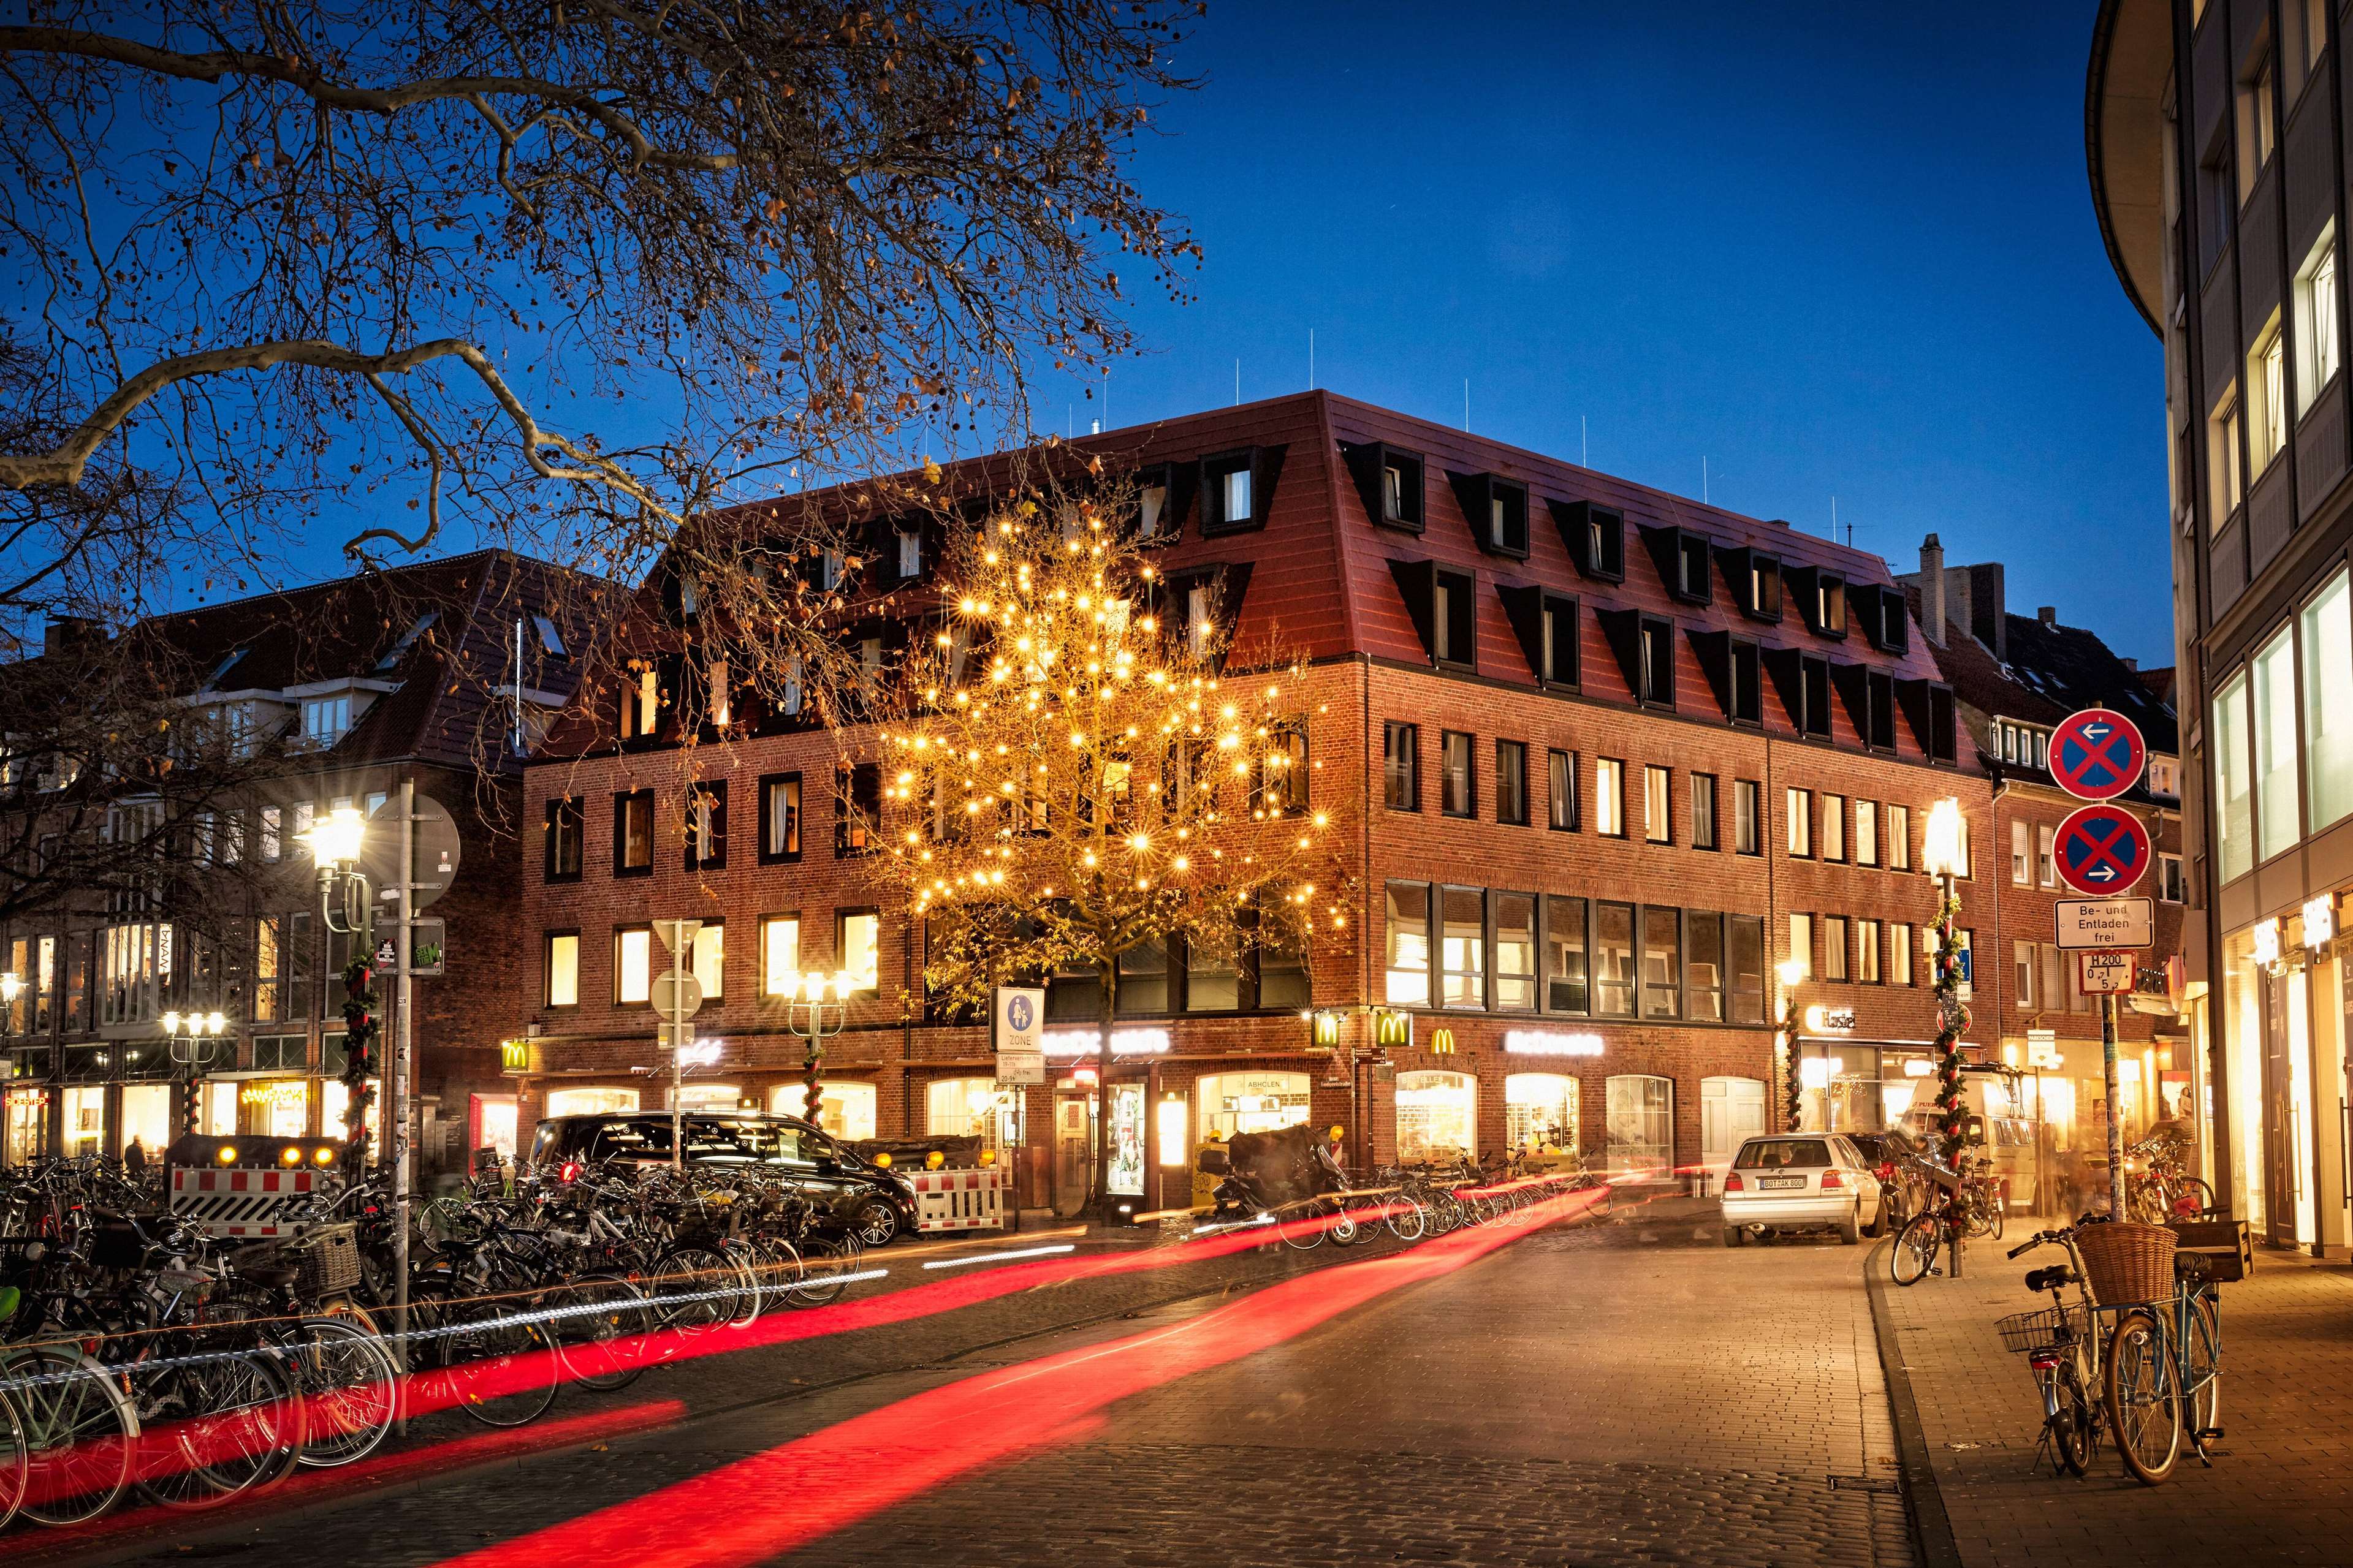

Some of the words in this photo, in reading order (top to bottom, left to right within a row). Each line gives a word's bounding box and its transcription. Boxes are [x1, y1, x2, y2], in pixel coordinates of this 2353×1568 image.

[2080, 906, 2100, 915] Be-
[2106, 905, 2127, 915] und
[2079, 919, 2129, 929] Entladen
[2094, 933, 2114, 942] frei
[2102, 955, 2121, 965] 200
[1009, 1035, 1031, 1045] ZONE
[5, 1097, 45, 1106] SIDESTEP
